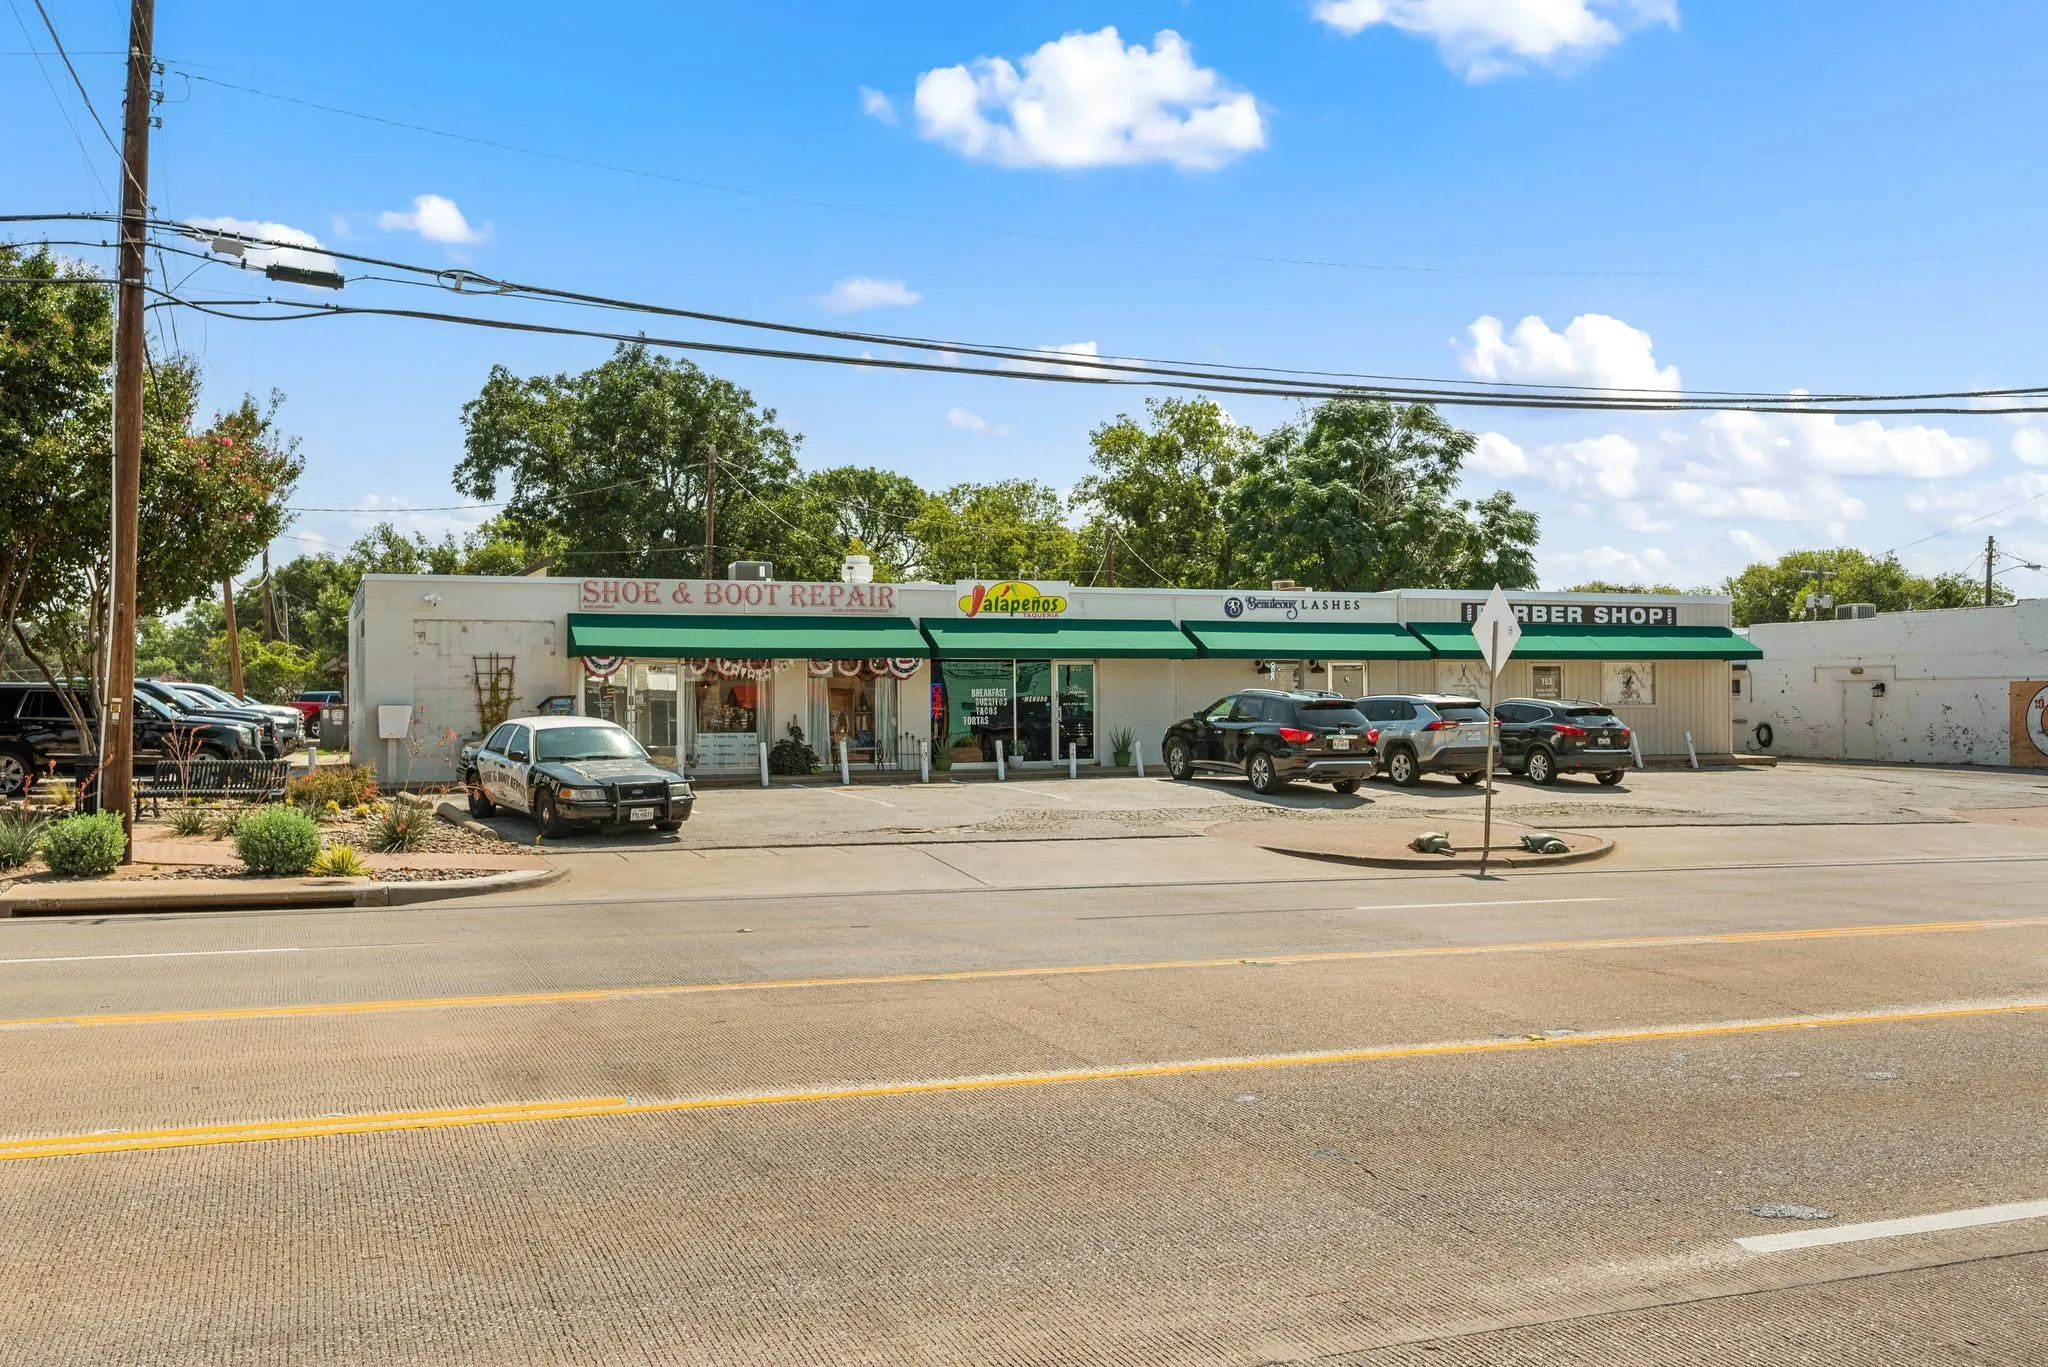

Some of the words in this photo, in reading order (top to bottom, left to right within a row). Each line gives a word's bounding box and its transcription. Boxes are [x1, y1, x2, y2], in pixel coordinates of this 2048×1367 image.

[582, 580, 662, 604] SHOE
[672, 581, 693, 605] &
[704, 582, 782, 606] BOOT
[790, 585, 896, 609] REPAIR
[1245, 596, 1298, 620] Beauteous
[1301, 600, 1360, 610] LASHES
[1476, 605, 1583, 623] RBER
[1594, 607, 1664, 625] SHOP
[1541, 677, 1553, 686] 153
[971, 688, 1007, 697] BREAKFAST
[975, 698, 1008, 706] BURRITOS
[975, 707, 998, 715] TACOS
[963, 716, 989, 725] TORTAS
